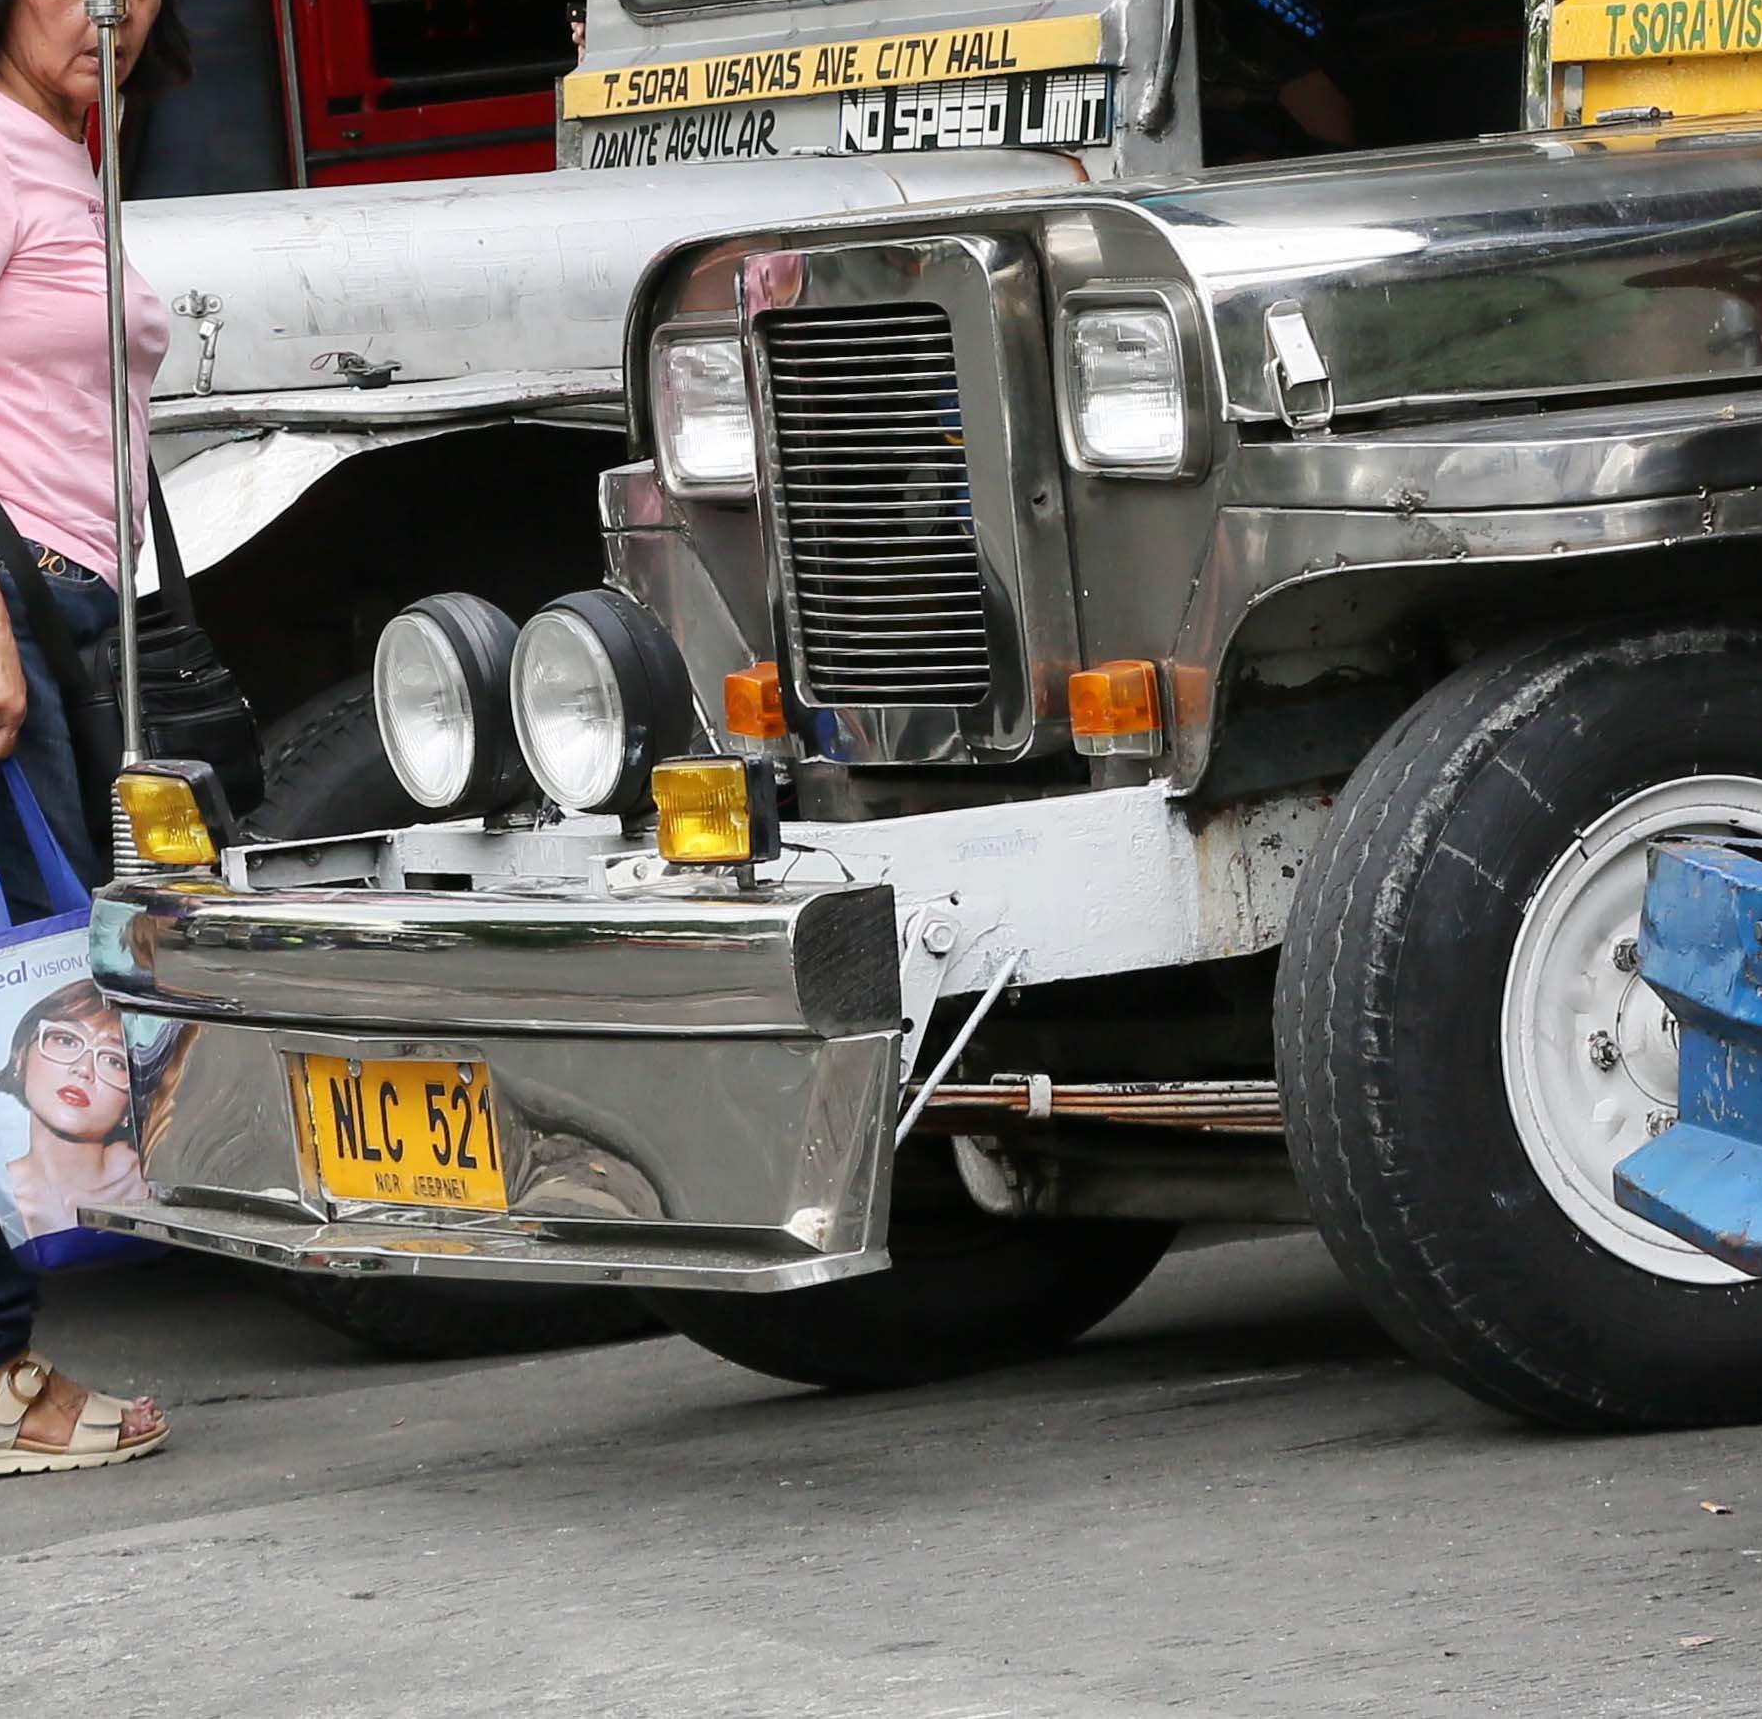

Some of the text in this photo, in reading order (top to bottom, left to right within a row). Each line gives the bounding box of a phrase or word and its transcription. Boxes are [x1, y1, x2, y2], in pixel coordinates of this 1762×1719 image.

[603, 26, 1018, 109] T.SORA VISAYAS AVE. CITY HALL
[589, 111, 779, 169] DANTE AGUILAR
[839, 75, 1108, 151] NO SPEED LIMIT
[31, 953, 83, 979] VISION
[330, 1077, 498, 1171] NLC 521
[374, 1172, 470, 1200] NCR JEEPNEY
